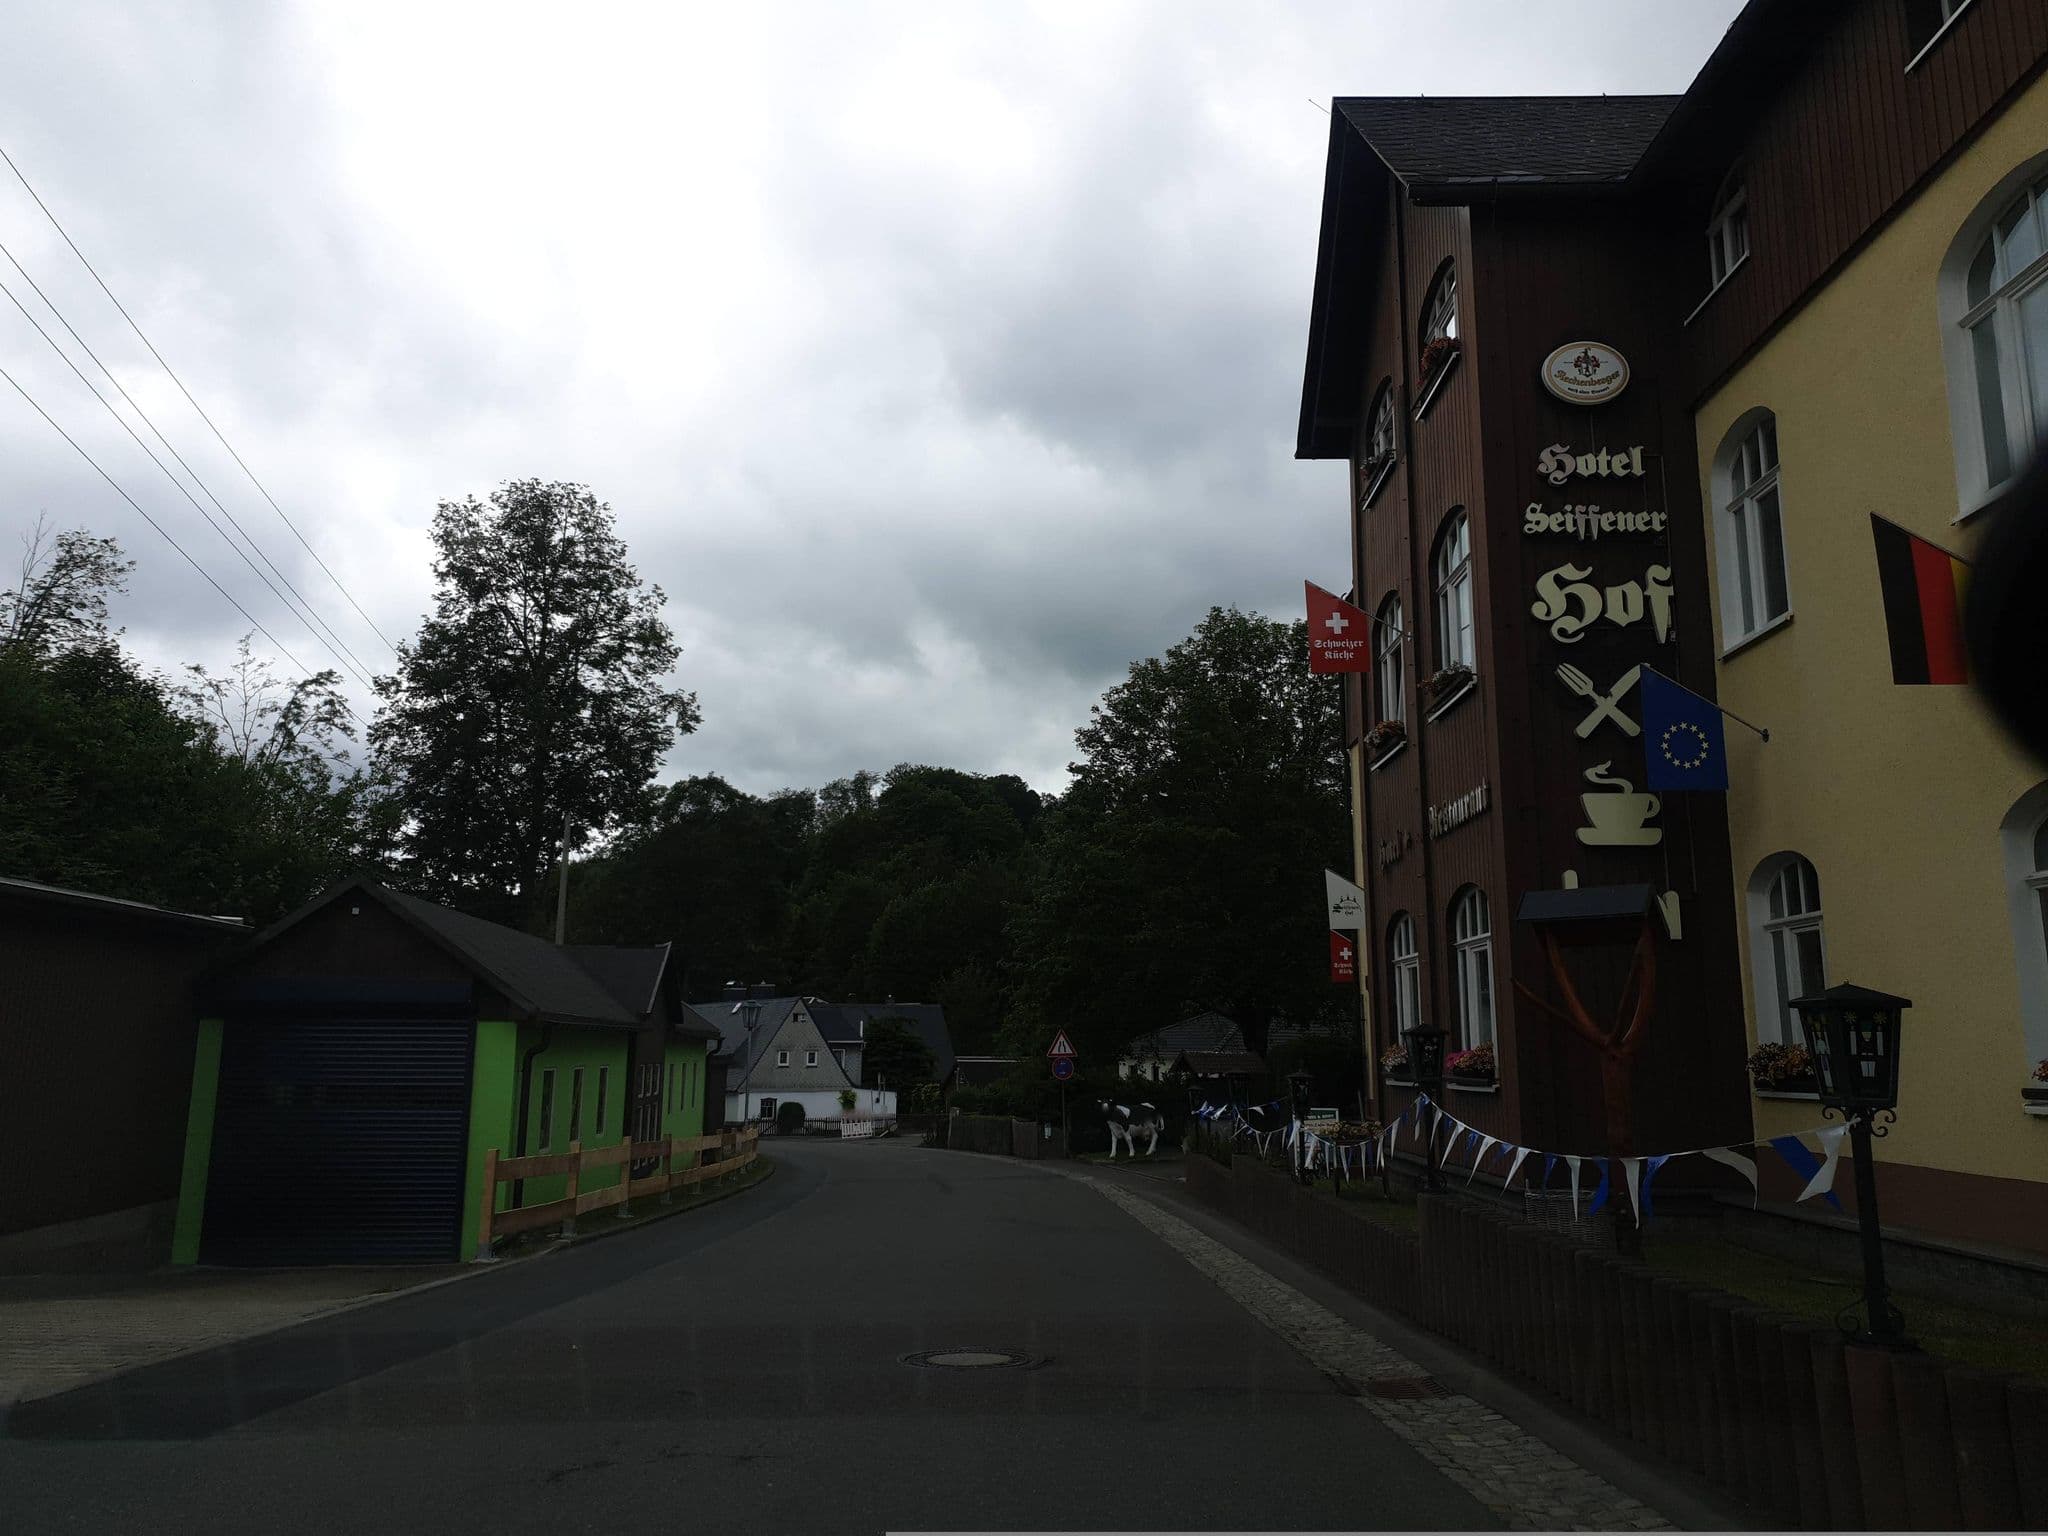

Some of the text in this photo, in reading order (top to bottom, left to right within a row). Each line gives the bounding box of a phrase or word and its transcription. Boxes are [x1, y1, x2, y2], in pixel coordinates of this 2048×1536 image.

[1536, 443, 1646, 485] Hotel
[1522, 502, 1667, 541] Seiffener
[1530, 562, 1674, 644] Hof
[1313, 639, 1365, 650] Schweizer
[1324, 650, 1355, 660] Küche
[1428, 776, 1489, 840] Restaurant
